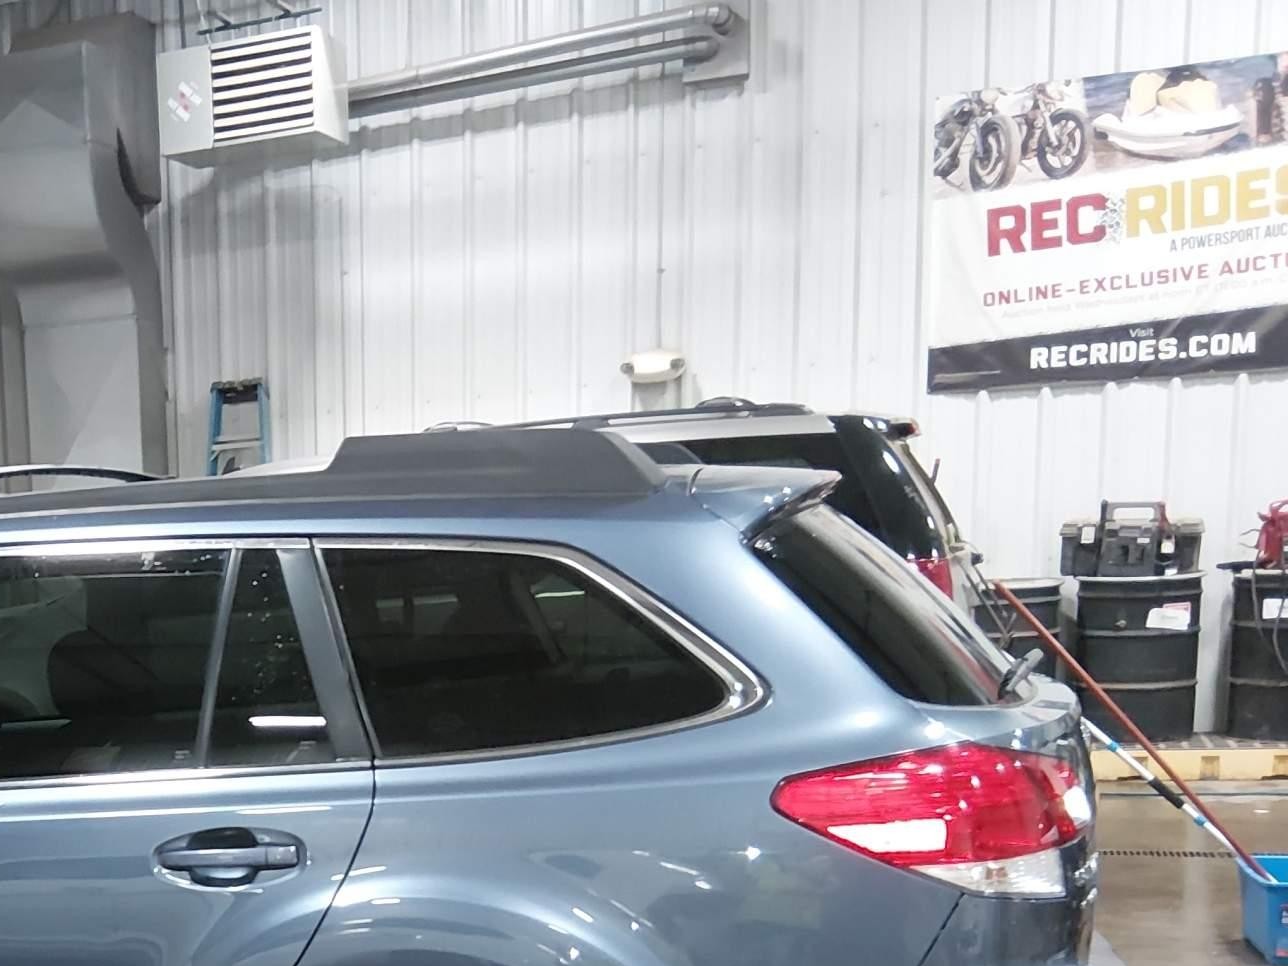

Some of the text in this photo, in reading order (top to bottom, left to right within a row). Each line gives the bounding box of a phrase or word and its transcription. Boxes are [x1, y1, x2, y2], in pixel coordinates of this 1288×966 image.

[986, 192, 1107, 257] REC
[1169, 238, 1178, 253] A
[1180, 226, 1261, 250] POWERSPORT
[982, 263, 1210, 307] ONLINE-EXCLUSIVE
[1029, 331, 1257, 370] RECRIDES.COM
[1128, 326, 1155, 338] Visit
